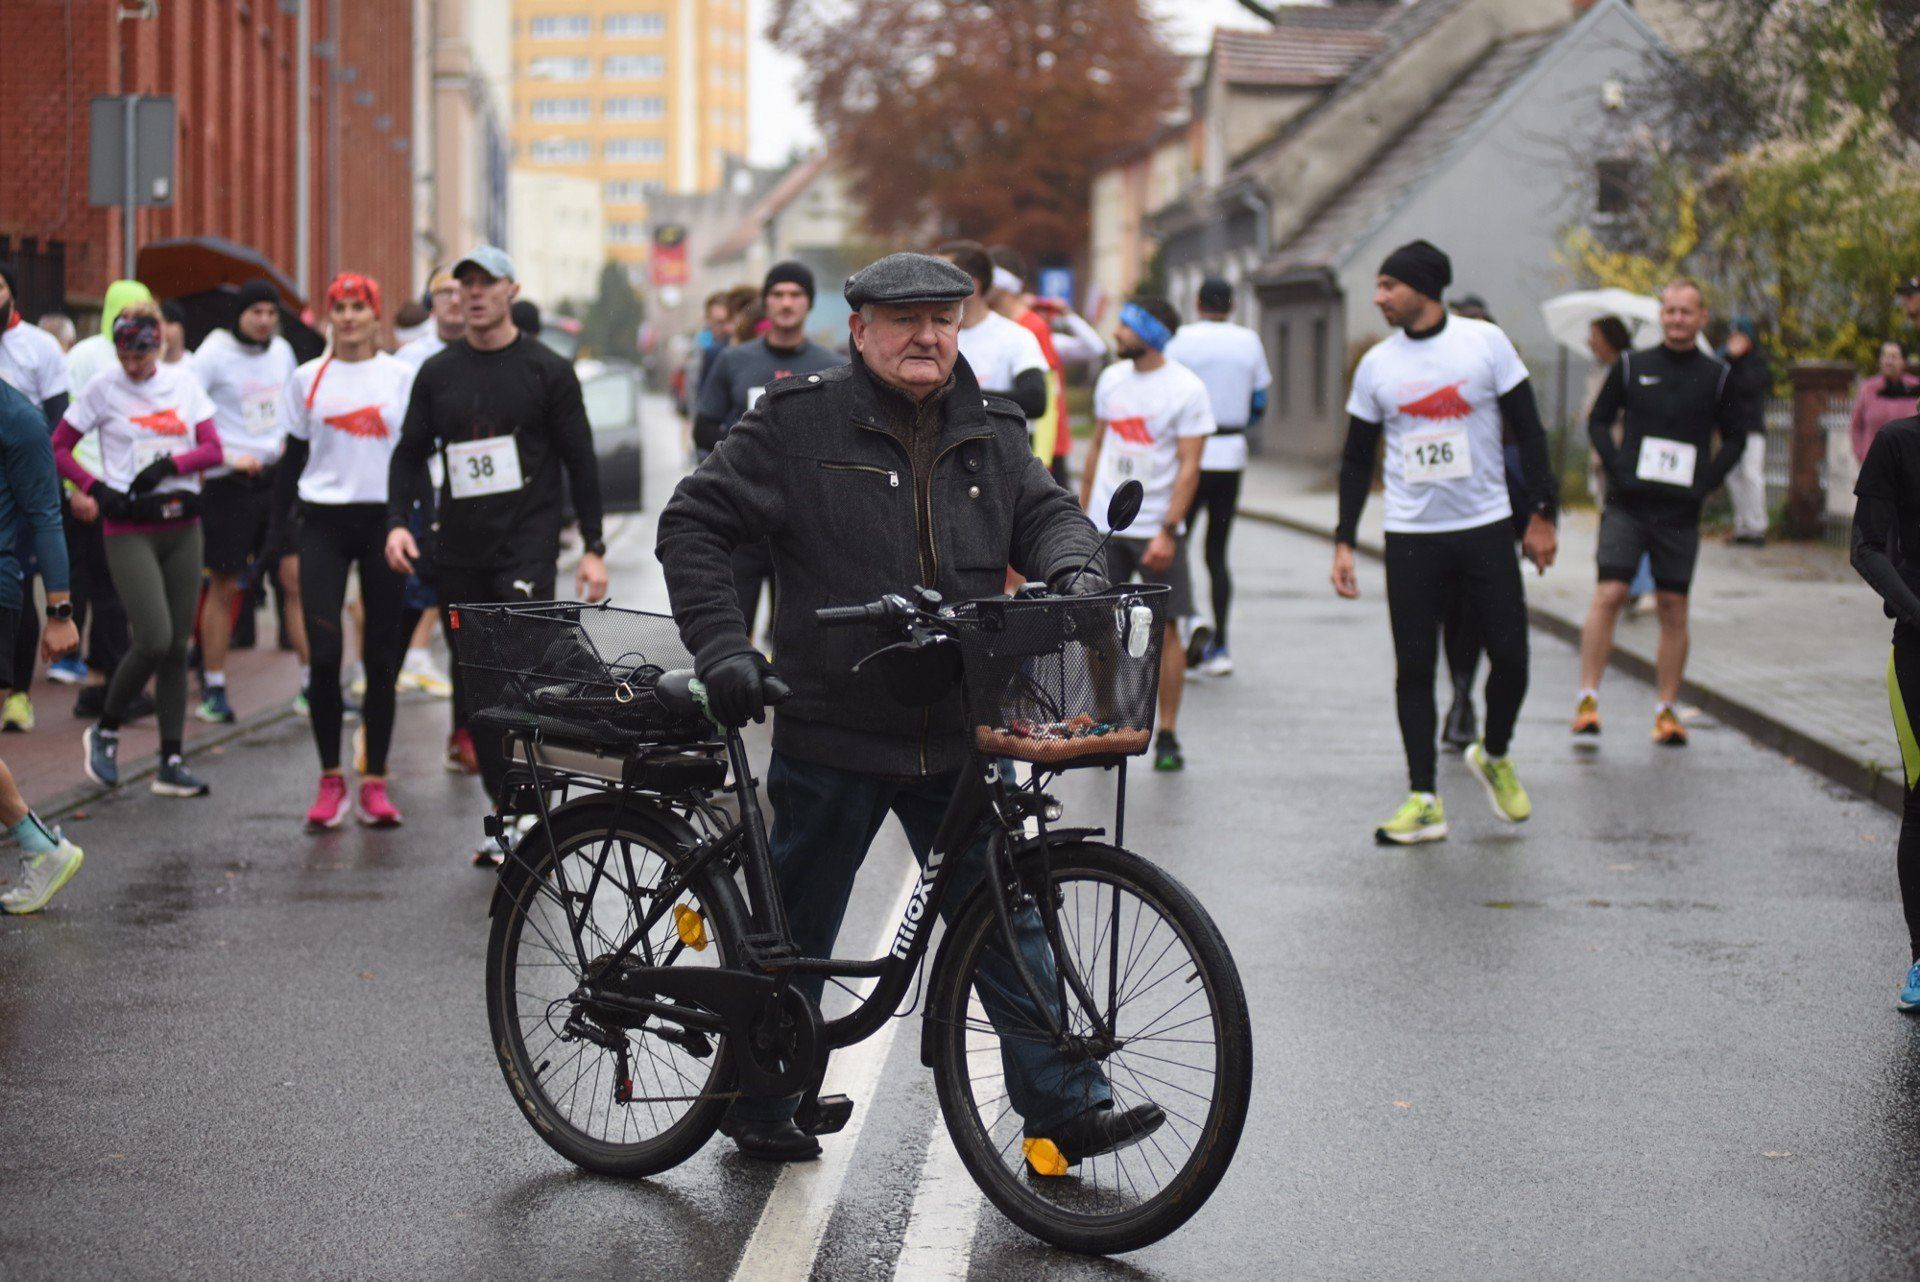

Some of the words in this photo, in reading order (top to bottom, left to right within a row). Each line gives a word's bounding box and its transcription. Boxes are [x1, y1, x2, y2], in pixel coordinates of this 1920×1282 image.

[467, 454, 495, 479] 38
[1416, 442, 1454, 466] 126
[891, 876, 934, 960] nilox
